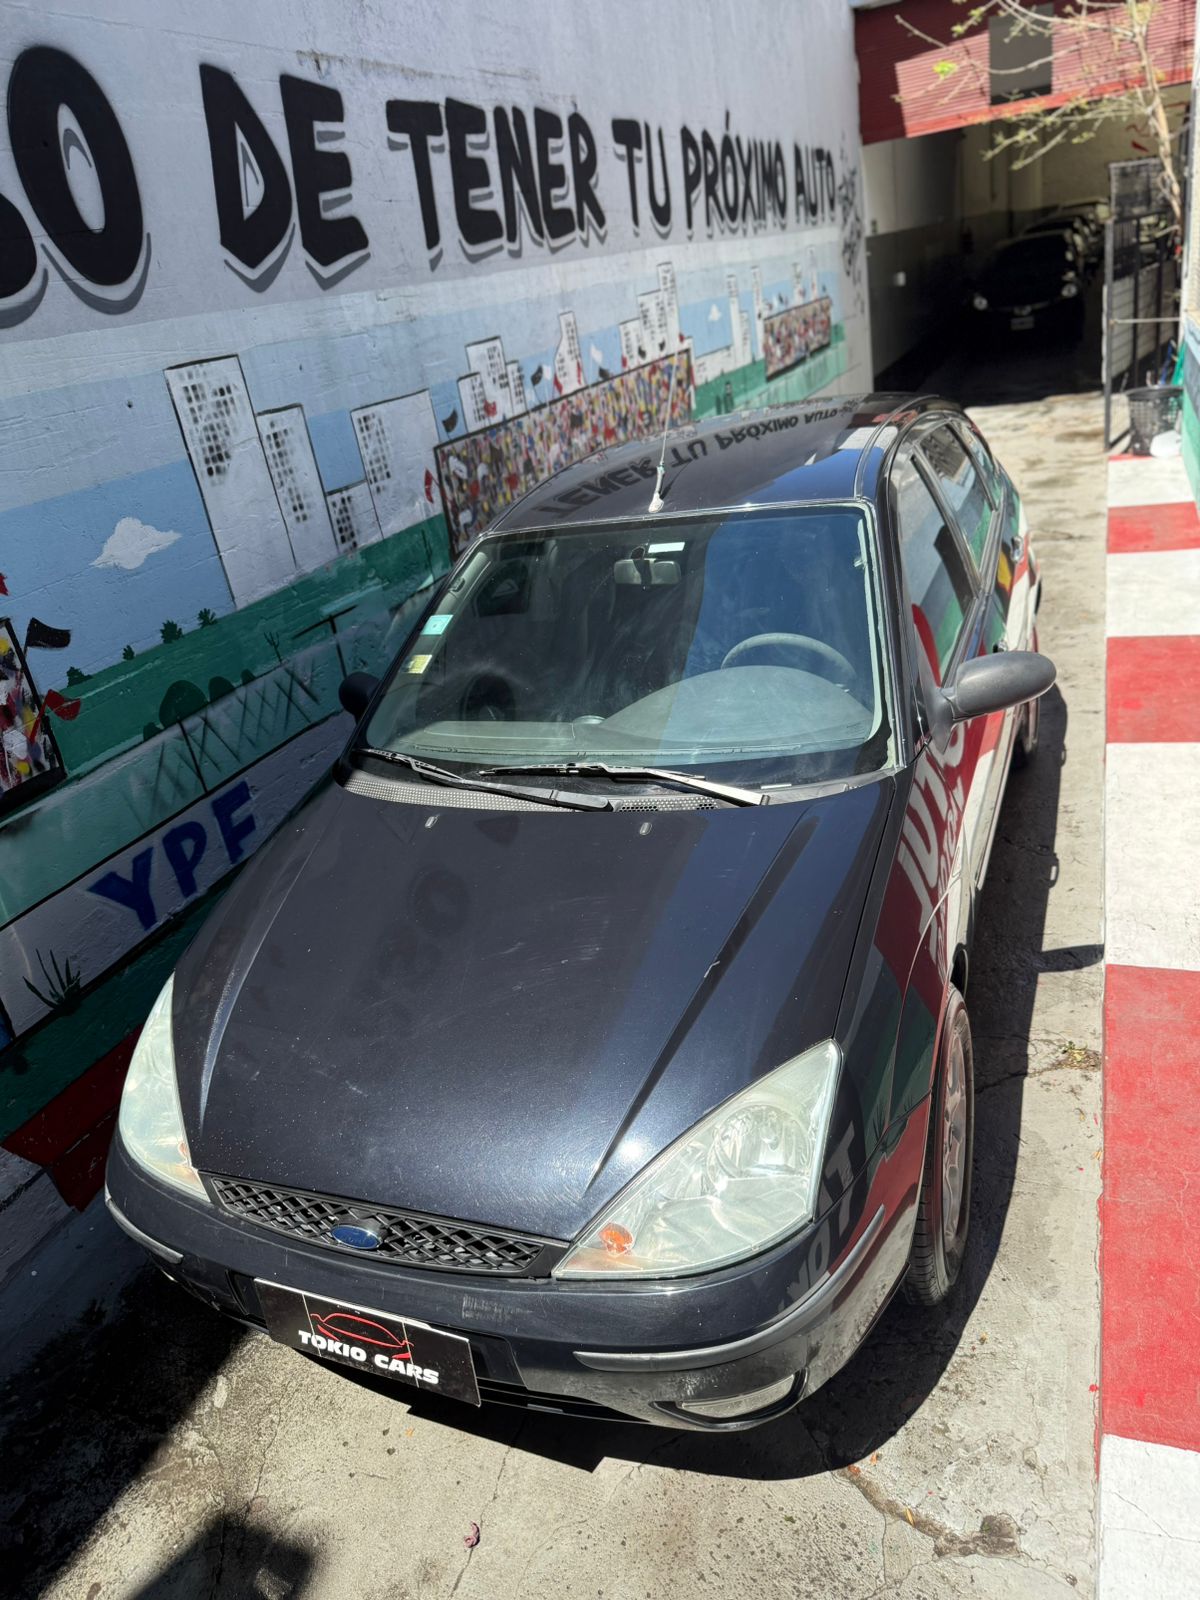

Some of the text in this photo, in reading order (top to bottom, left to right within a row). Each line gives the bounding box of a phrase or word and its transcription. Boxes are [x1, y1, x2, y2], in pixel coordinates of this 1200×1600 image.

[200, 63, 370, 270] DE
[386, 97, 607, 251] TENER
[612, 119, 672, 229] TU
[681, 110, 788, 231] PRÓXIMO
[794, 142, 836, 219] AUTO
[87, 780, 257, 932] YPF
[298, 1330, 440, 1386] TOKIO CARS
